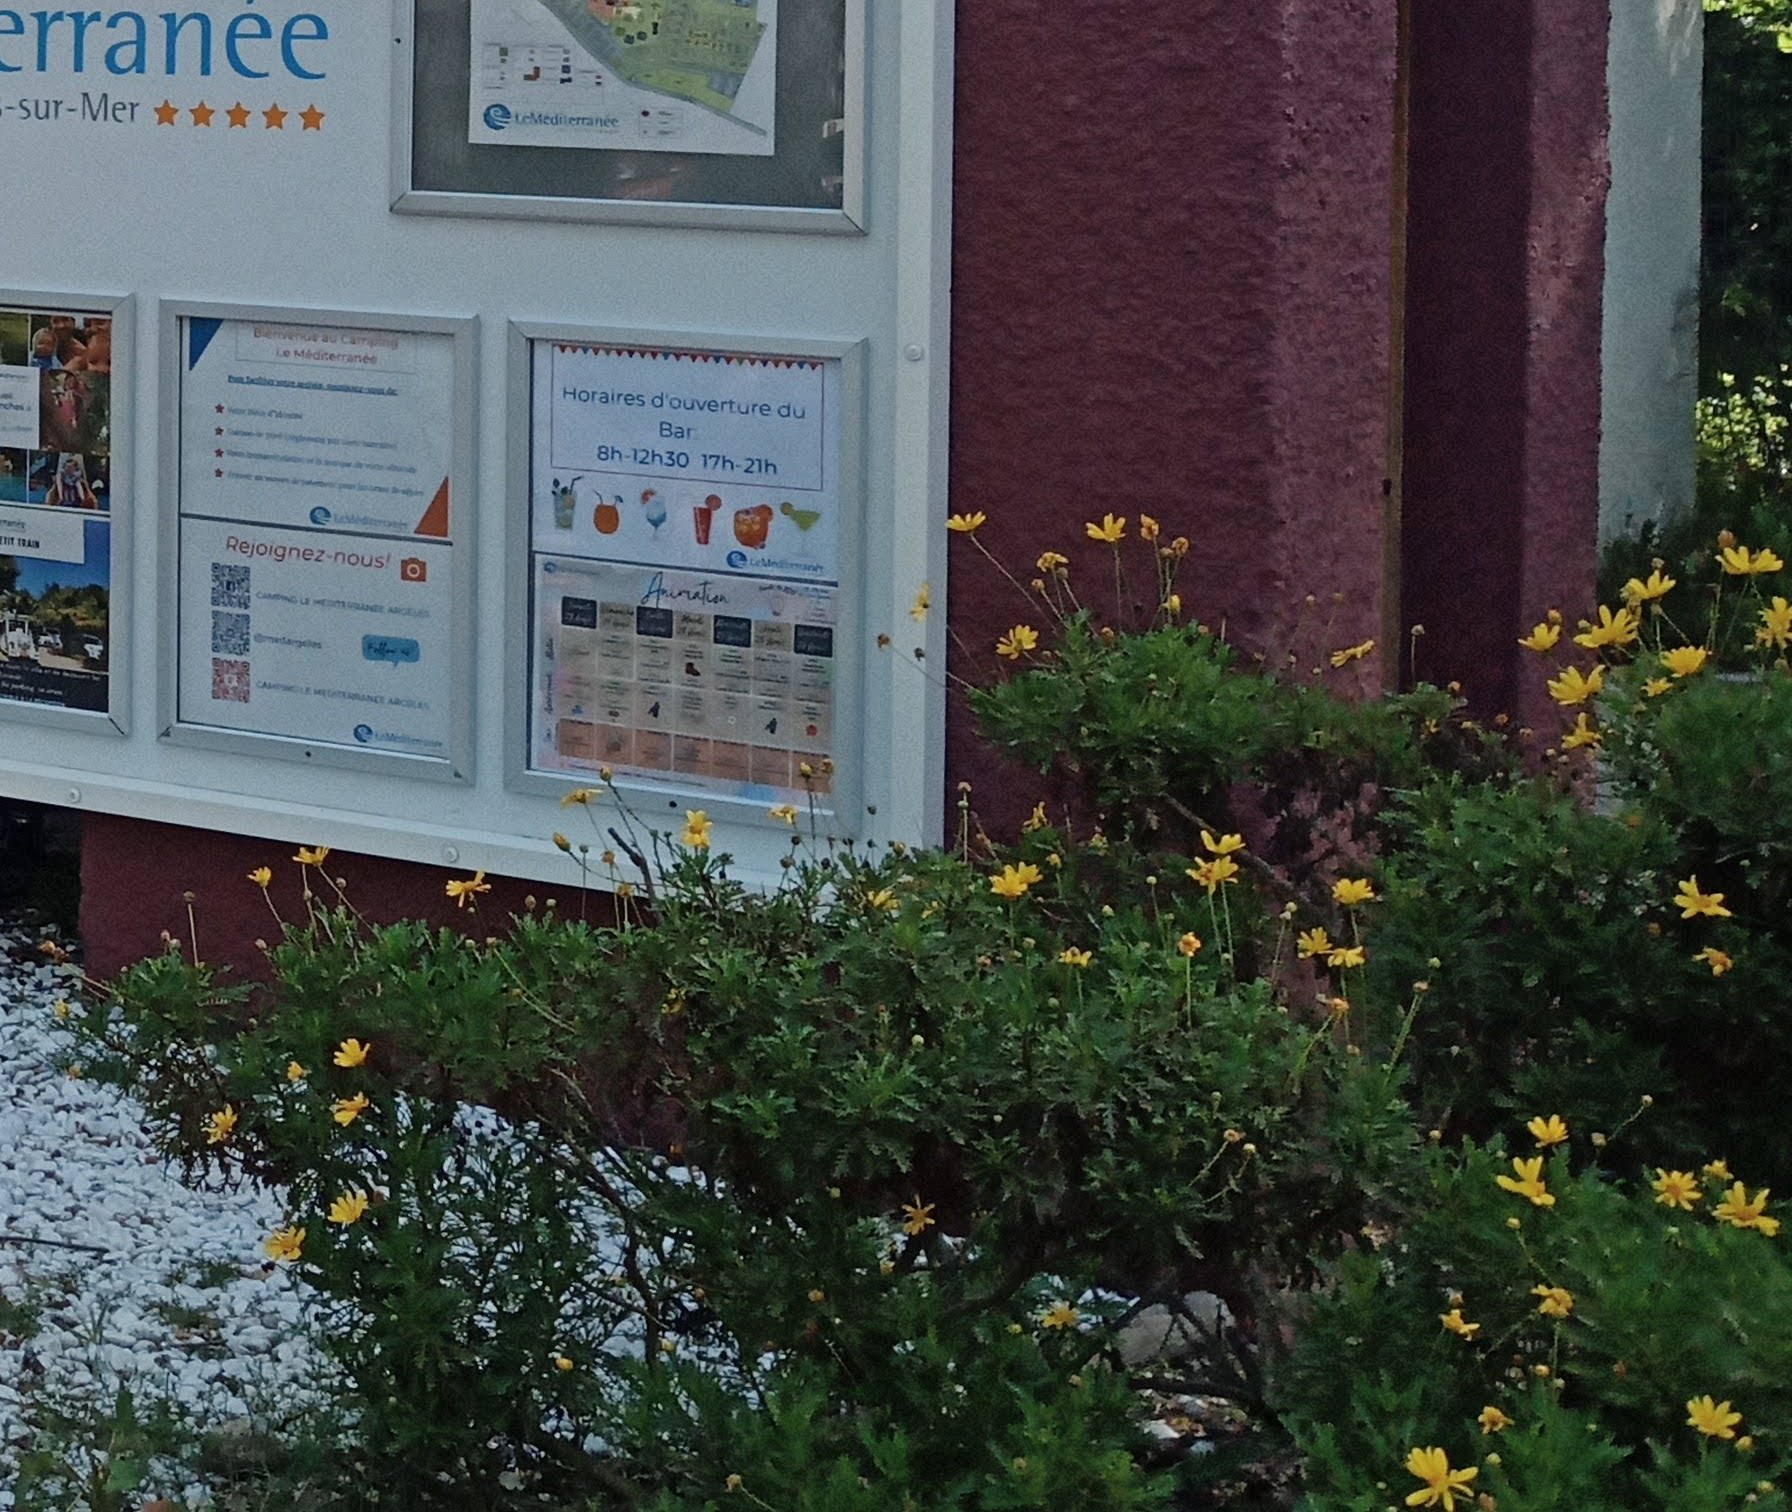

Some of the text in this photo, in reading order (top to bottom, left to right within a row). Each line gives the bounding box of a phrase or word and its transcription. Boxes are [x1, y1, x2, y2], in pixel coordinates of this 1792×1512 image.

[253, 326, 399, 350] Bienvenue au Camping
[276, 348, 378, 365] Le Méditerranée
[562, 386, 807, 419] Horaires d'ouverture du
[596, 445, 778, 476] 8h-12h30 17h-21h
[16, 537, 41, 549] TRAIN
[255, 590, 298, 605] CAMPING
[300, 597, 310, 606] LE
[640, 571, 731, 609] Animation
